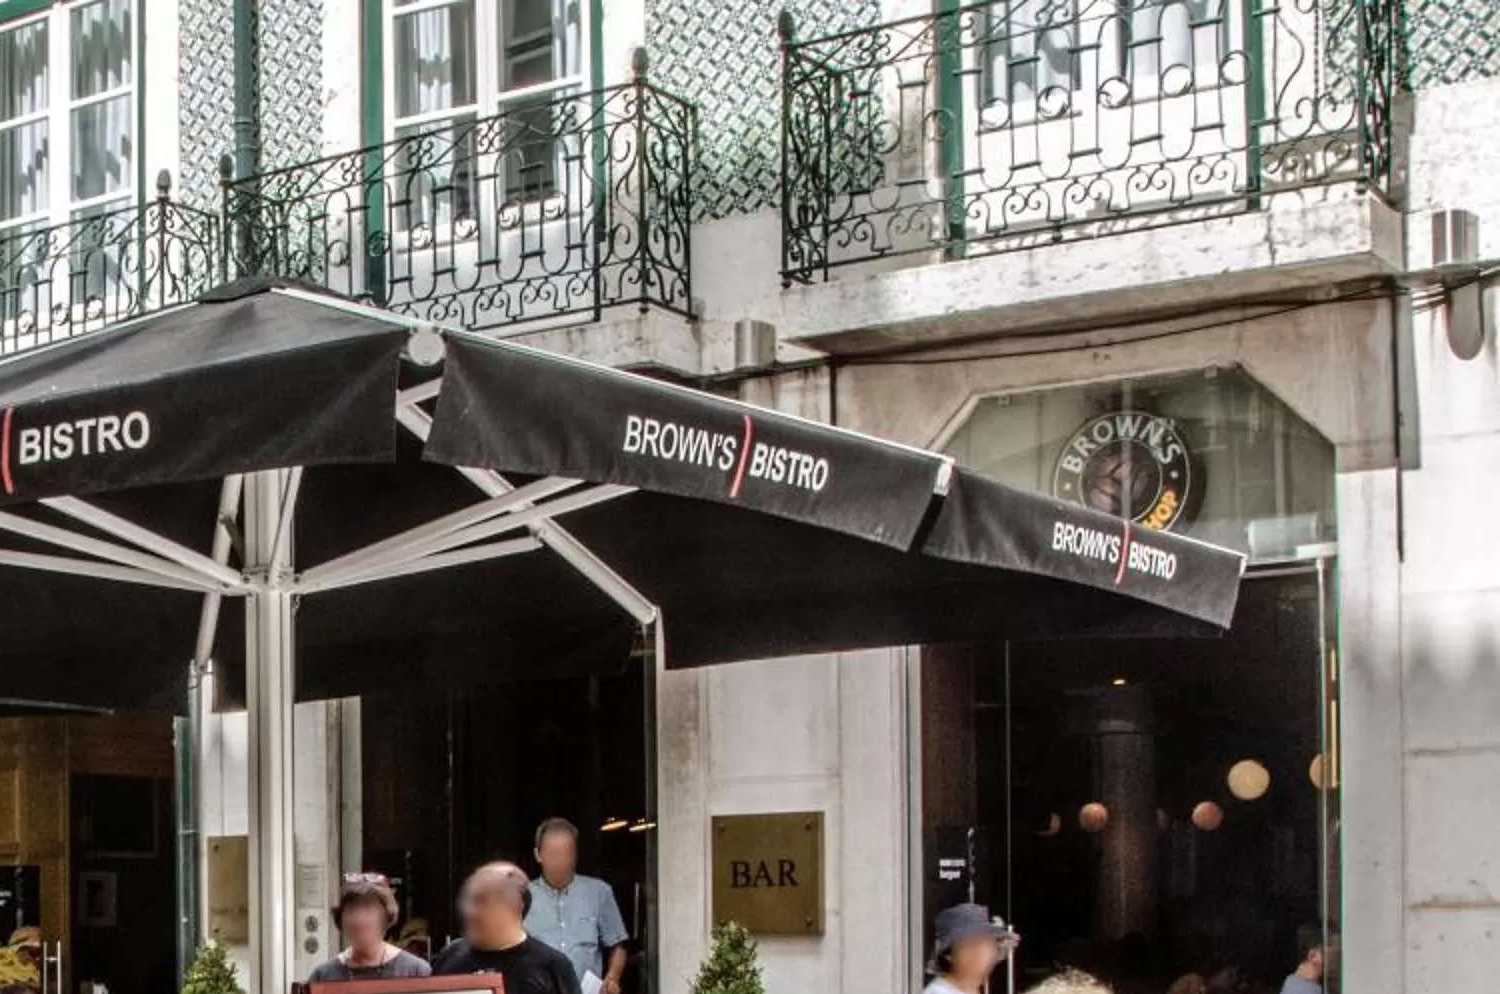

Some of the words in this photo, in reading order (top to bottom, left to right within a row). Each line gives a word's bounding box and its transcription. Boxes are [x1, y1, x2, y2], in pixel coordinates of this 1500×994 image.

[18, 410, 150, 465] BISTRO
[623, 415, 737, 471] BROWN'S
[748, 442, 829, 491] BISTRO
[1062, 415, 1181, 474] BROWN'S
[1052, 521, 1121, 564] BROWN'S
[1126, 541, 1177, 581] BISTRO
[730, 859, 800, 889] BAR
